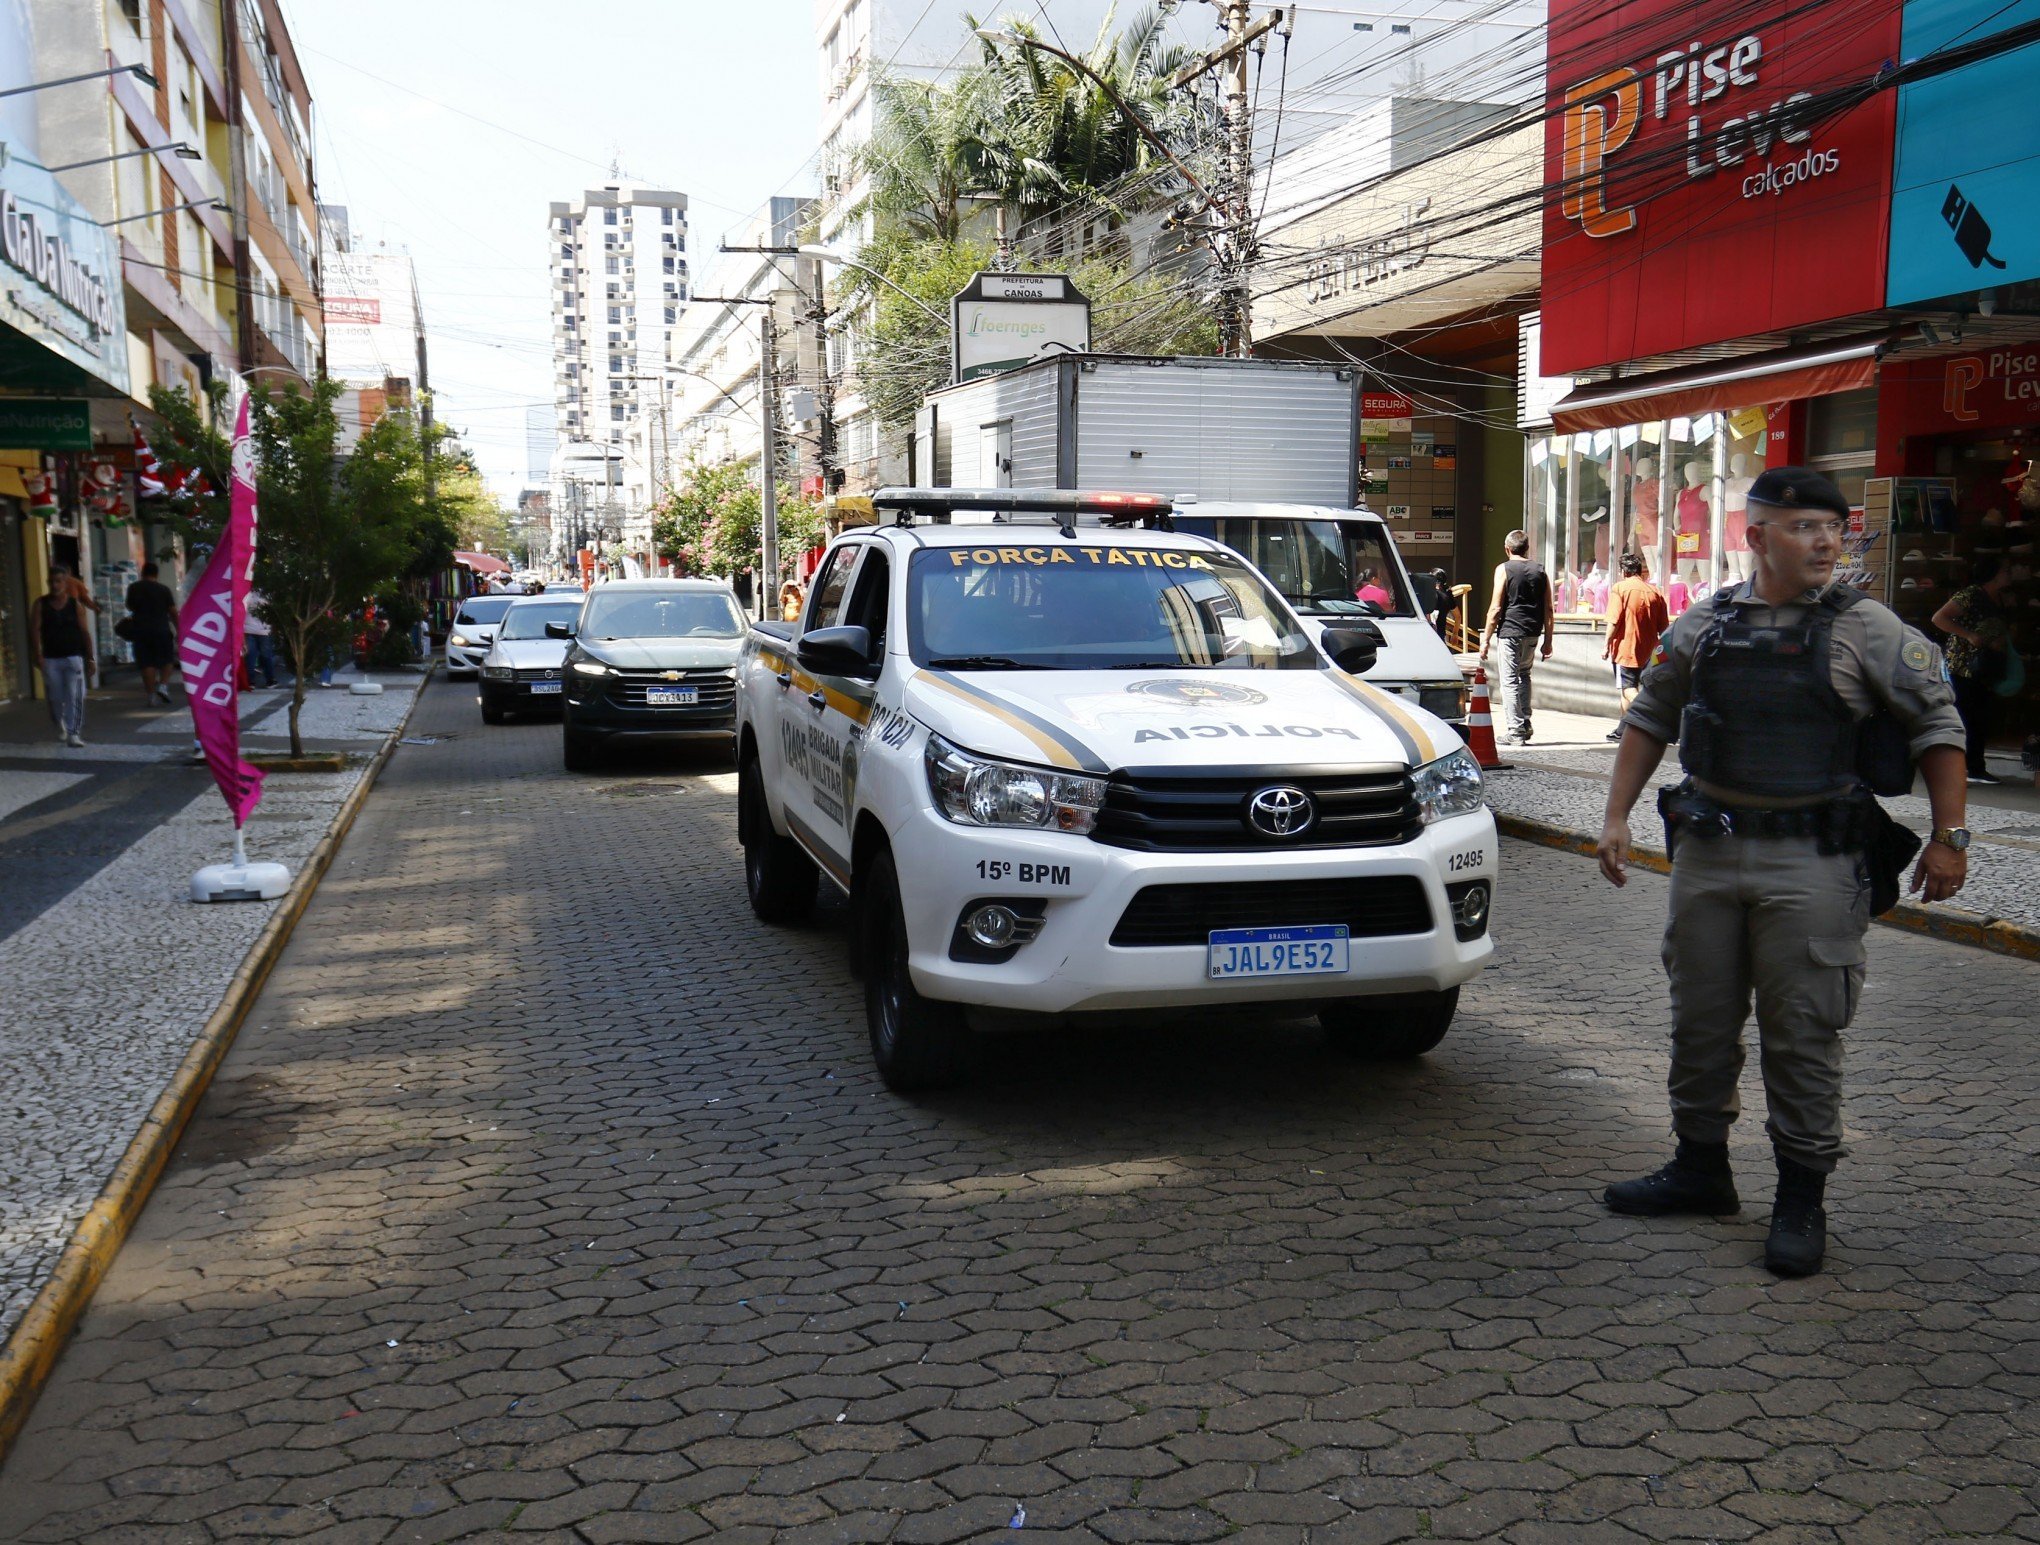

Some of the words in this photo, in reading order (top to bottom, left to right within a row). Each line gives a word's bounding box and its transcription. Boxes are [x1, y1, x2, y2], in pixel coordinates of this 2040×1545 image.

[1655, 36, 1762, 119] Pise
[1687, 91, 1813, 178] Leve
[1742, 148, 1839, 198] calçados
[1002, 277, 1044, 285] PREFEITURA
[1004, 289, 1043, 298] CANOAS
[981, 317, 1046, 338] foernges
[1989, 351, 2037, 378] Pise
[1364, 399, 1407, 409] SEGURA
[1771, 431, 1785, 440] 189
[1389, 506, 1408, 514] ABC
[949, 548, 1075, 566] FORÇA
[1080, 547, 1215, 571] TÁTICA
[873, 702, 915, 751] POLÍCIA
[781, 717, 809, 782] 12495
[808, 724, 841, 767] BRIGADA
[810, 754, 843, 798] MILITAR
[976, 860, 1011, 880] 15º
[1019, 863, 1071, 885] BPM
[1448, 849, 1483, 871] 12495
[1223, 942, 1334, 973] JAL9E52
[1212, 966, 1221, 976] BR
